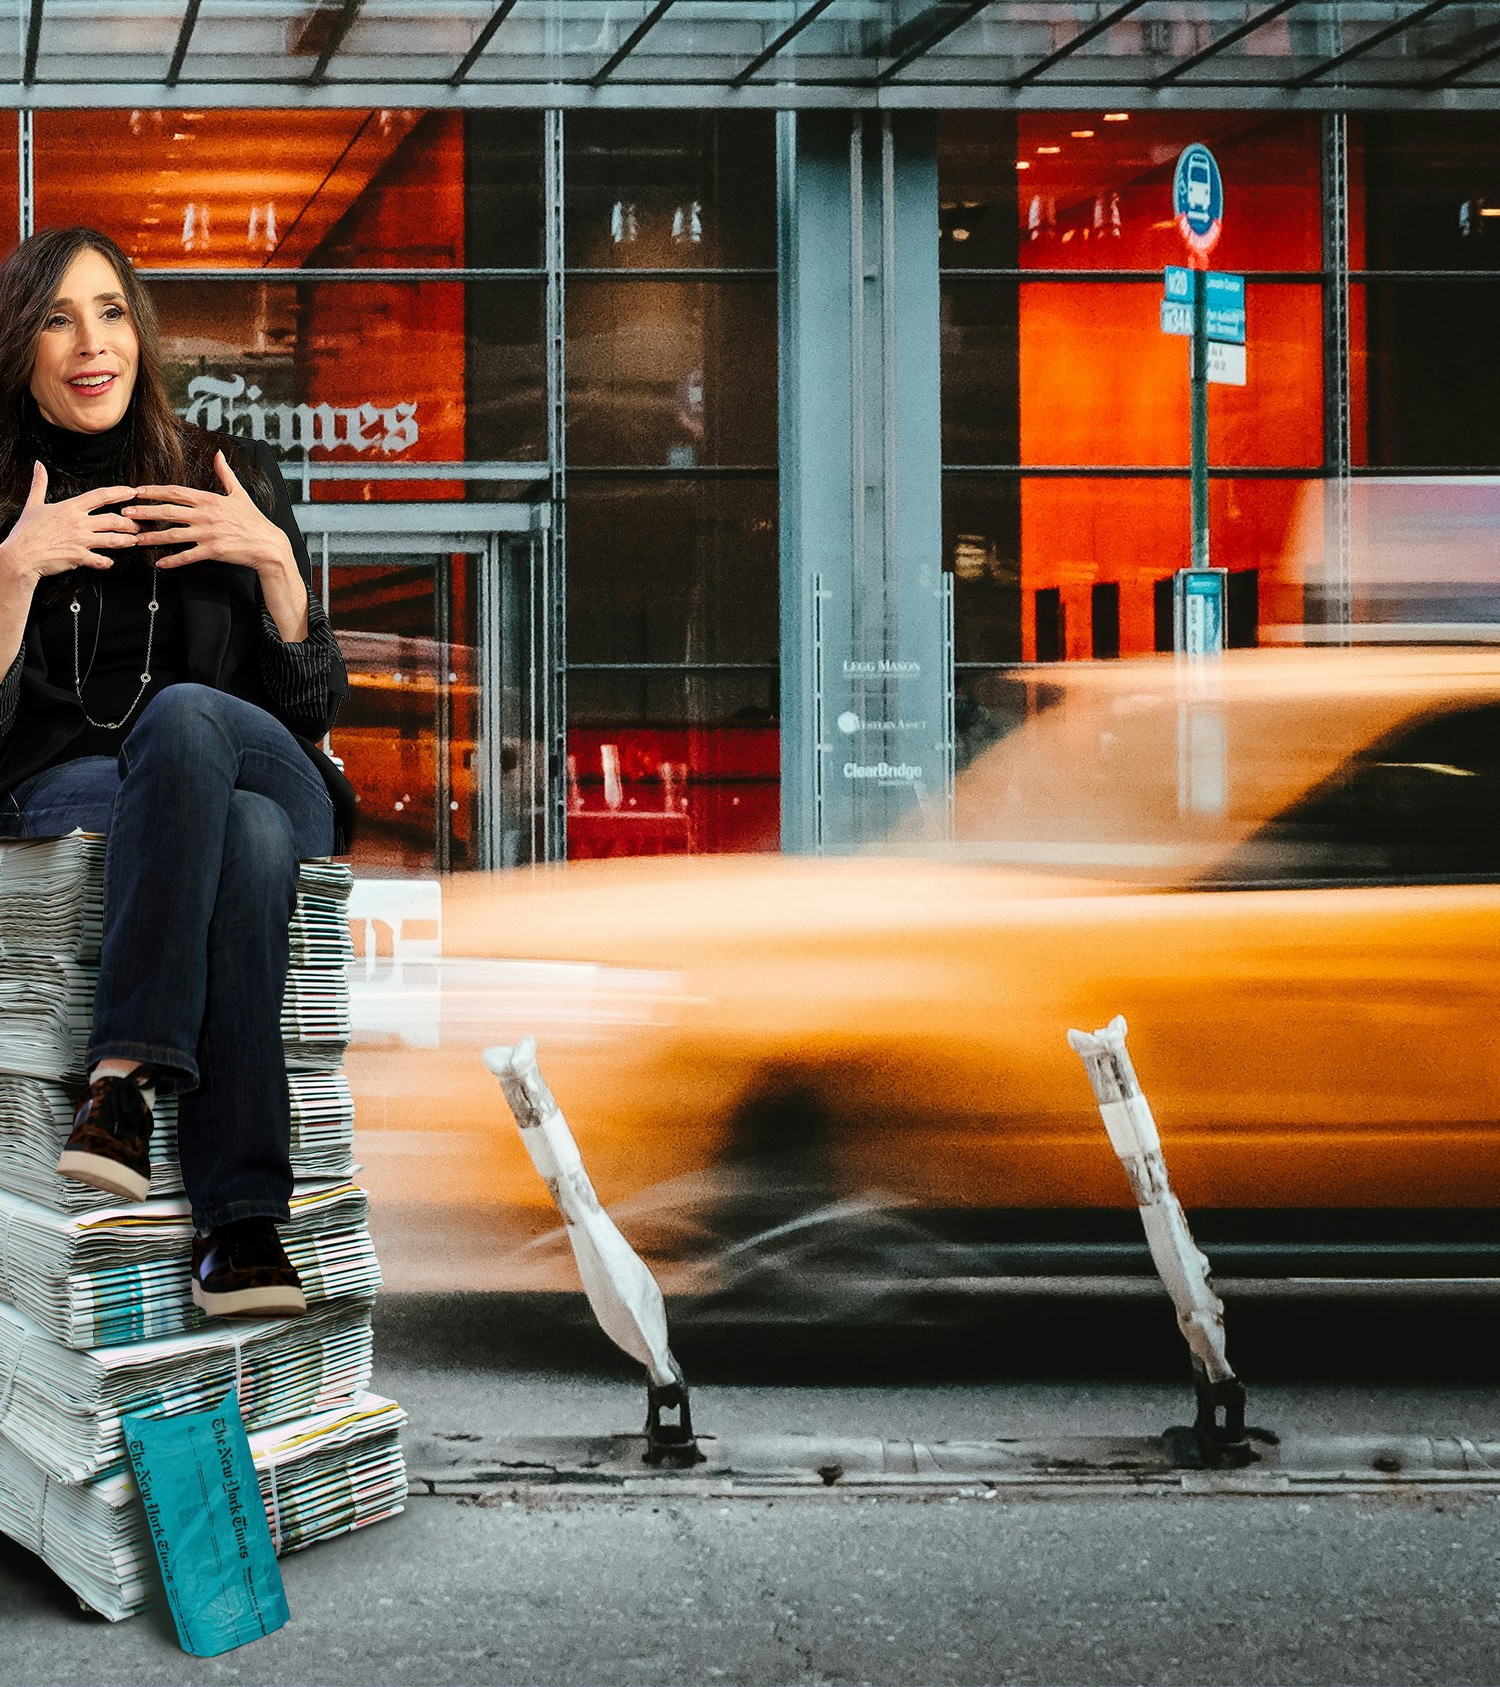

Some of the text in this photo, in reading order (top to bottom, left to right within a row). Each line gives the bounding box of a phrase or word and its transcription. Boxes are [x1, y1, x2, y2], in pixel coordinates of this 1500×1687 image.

[184, 373, 419, 453] Times
[842, 659, 921, 673] LEGG MASON
[843, 762, 922, 780] ClearBridge
[130, 1440, 173, 1583] The New York Times
[211, 1418, 249, 1559] The New York Times
